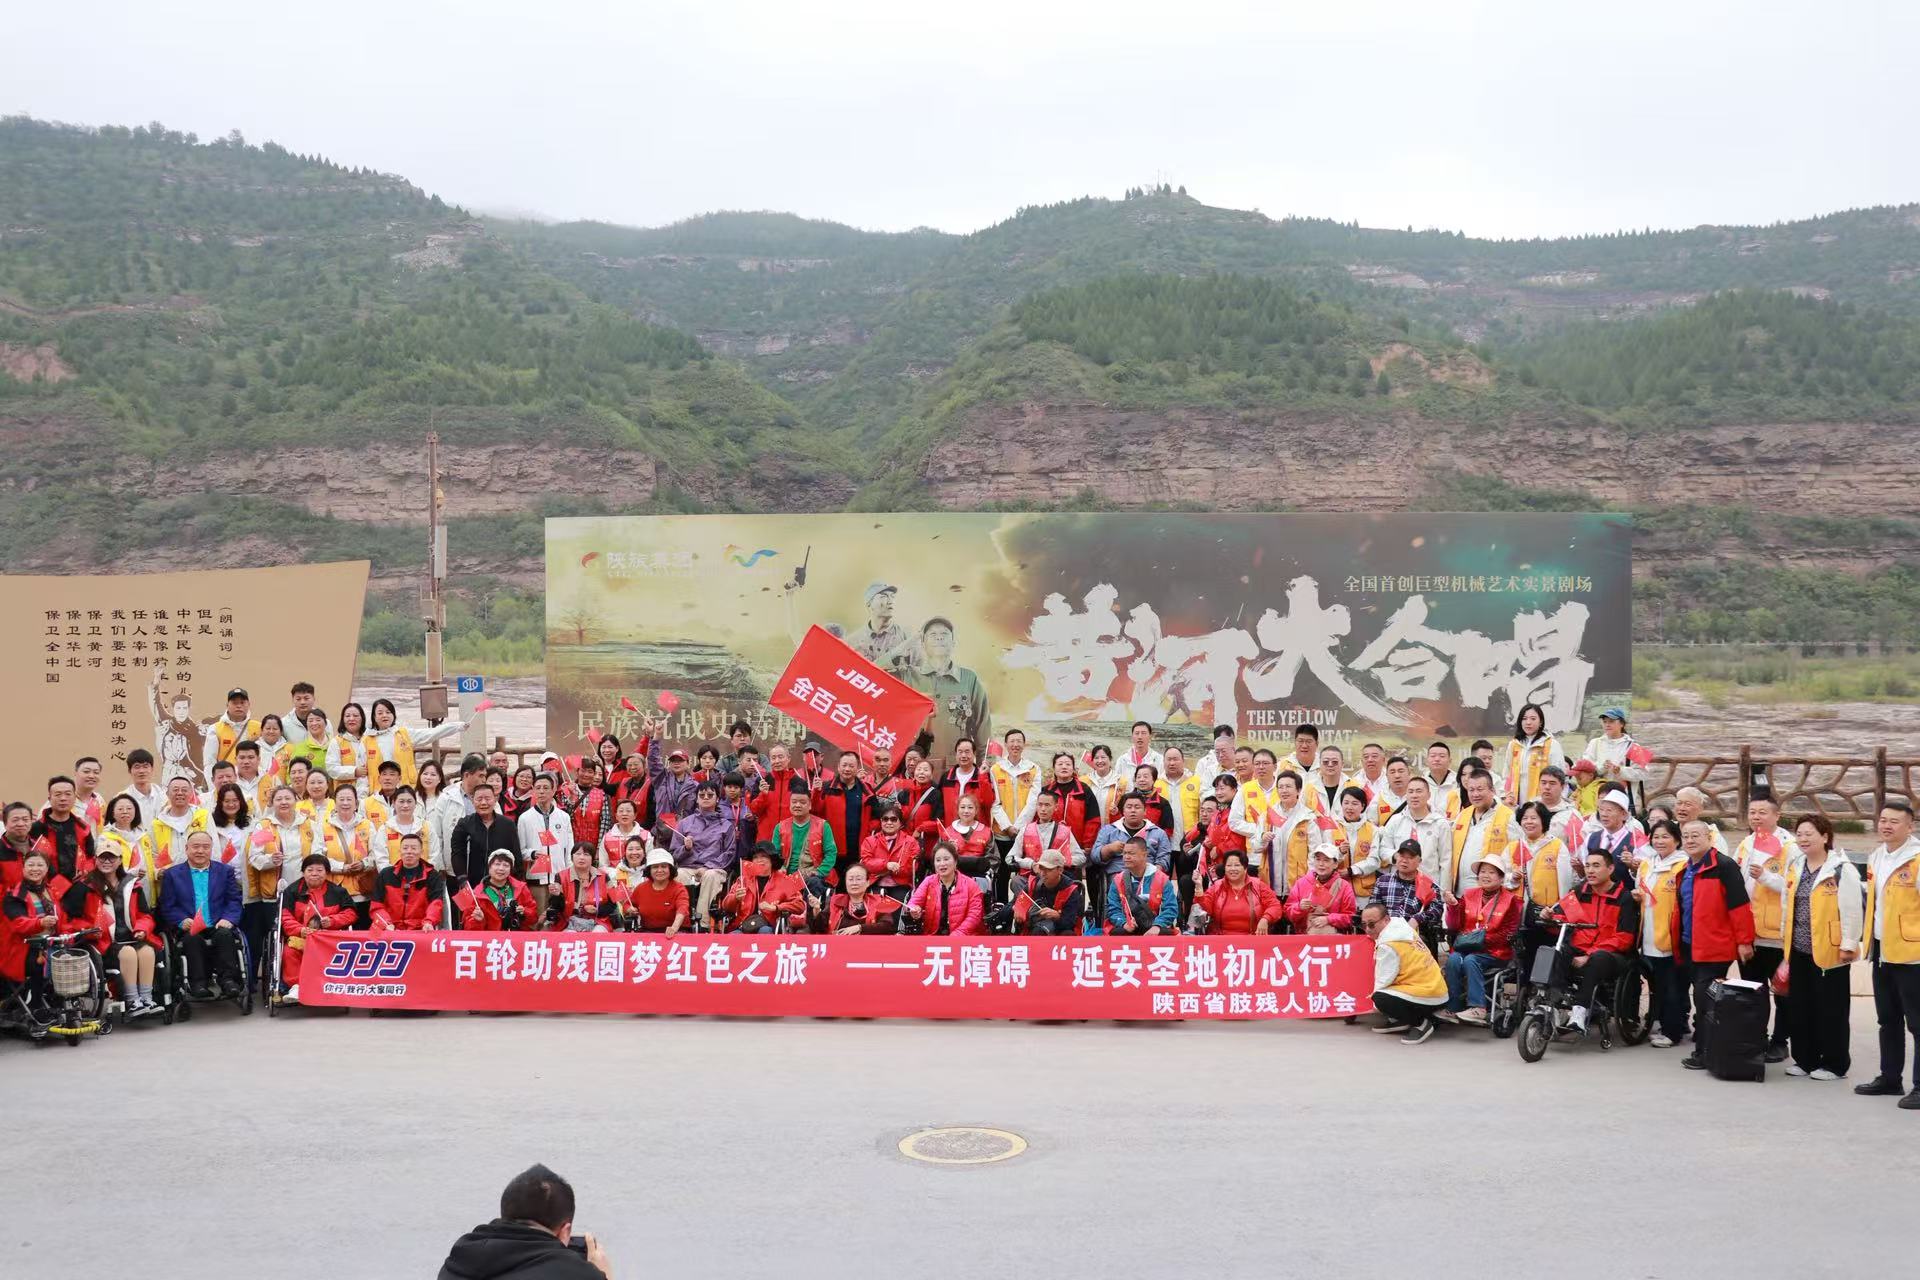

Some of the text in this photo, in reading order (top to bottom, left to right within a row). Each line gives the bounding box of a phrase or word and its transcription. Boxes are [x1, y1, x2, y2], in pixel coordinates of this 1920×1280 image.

[1343, 574, 1594, 593] 全国首创巨型机械艺术实景剧场
[66, 610, 82, 668] 保卫华北
[87, 610, 103, 668] 保卫黄河
[132, 609, 148, 667] 任人宰割
[197, 608, 213, 635] 但是
[44, 610, 61, 683] 保卫全中国
[1003, 574, 1595, 735] 黄河大合唱
[110, 609, 127, 761] 我们要抱定必胜的决心
[835, 667, 885, 699] JBH
[788, 676, 898, 750] 金百合公益
[1247, 709, 1338, 726] THE YELLOW
[1247, 729, 1291, 744] RIVER
[324, 983, 345, 994] 你行
[367, 985, 406, 996] 大家同行
[1152, 991, 1356, 1015] 陕西省肢残人协会
